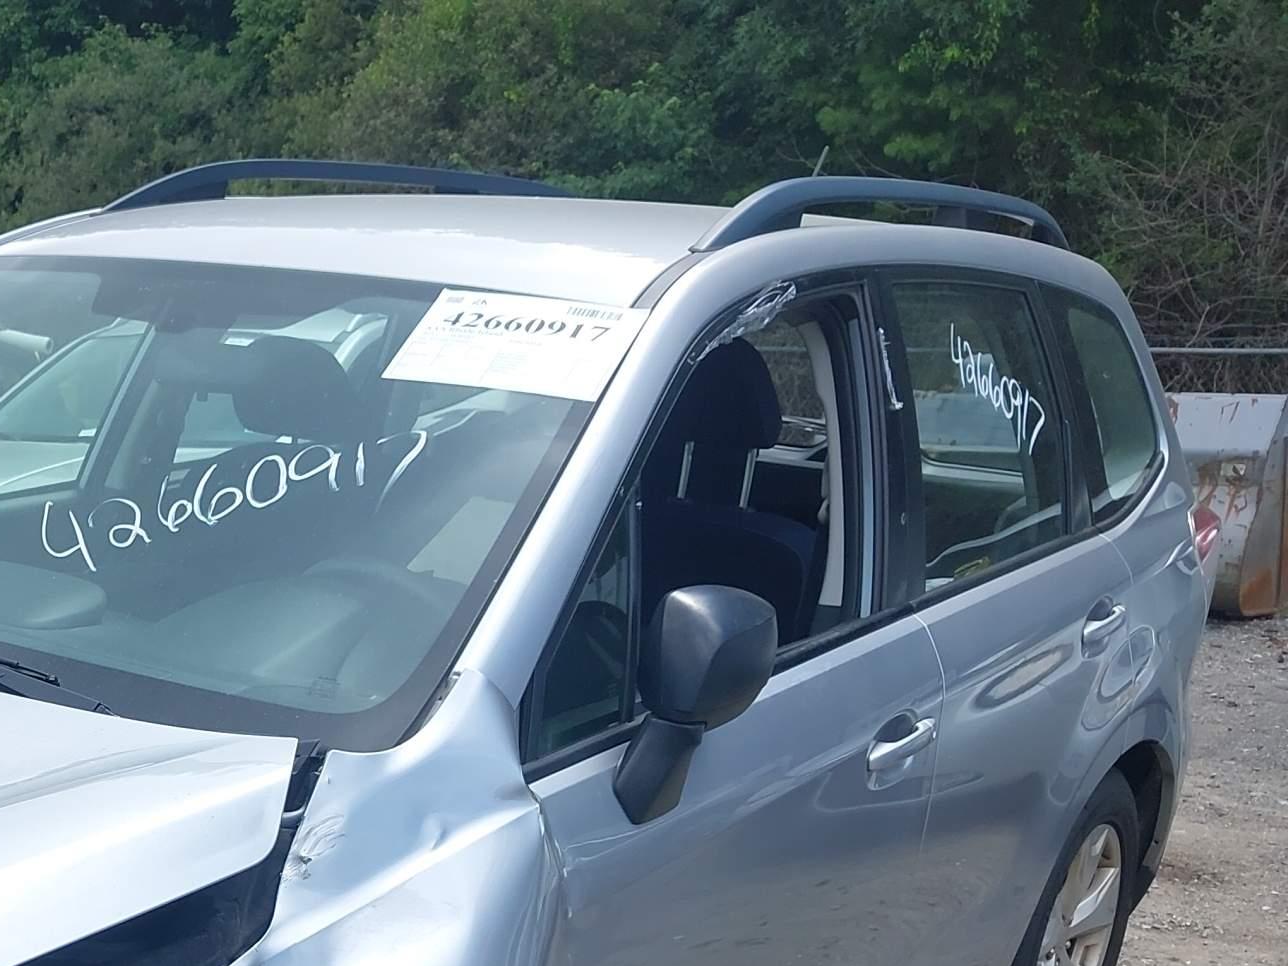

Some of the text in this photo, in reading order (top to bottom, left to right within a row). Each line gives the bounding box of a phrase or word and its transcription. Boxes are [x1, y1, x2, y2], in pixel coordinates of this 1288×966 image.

[443, 311, 611, 342] 42660917
[950, 322, 1045, 456] 42660917
[41, 430, 428, 572] 42660917
